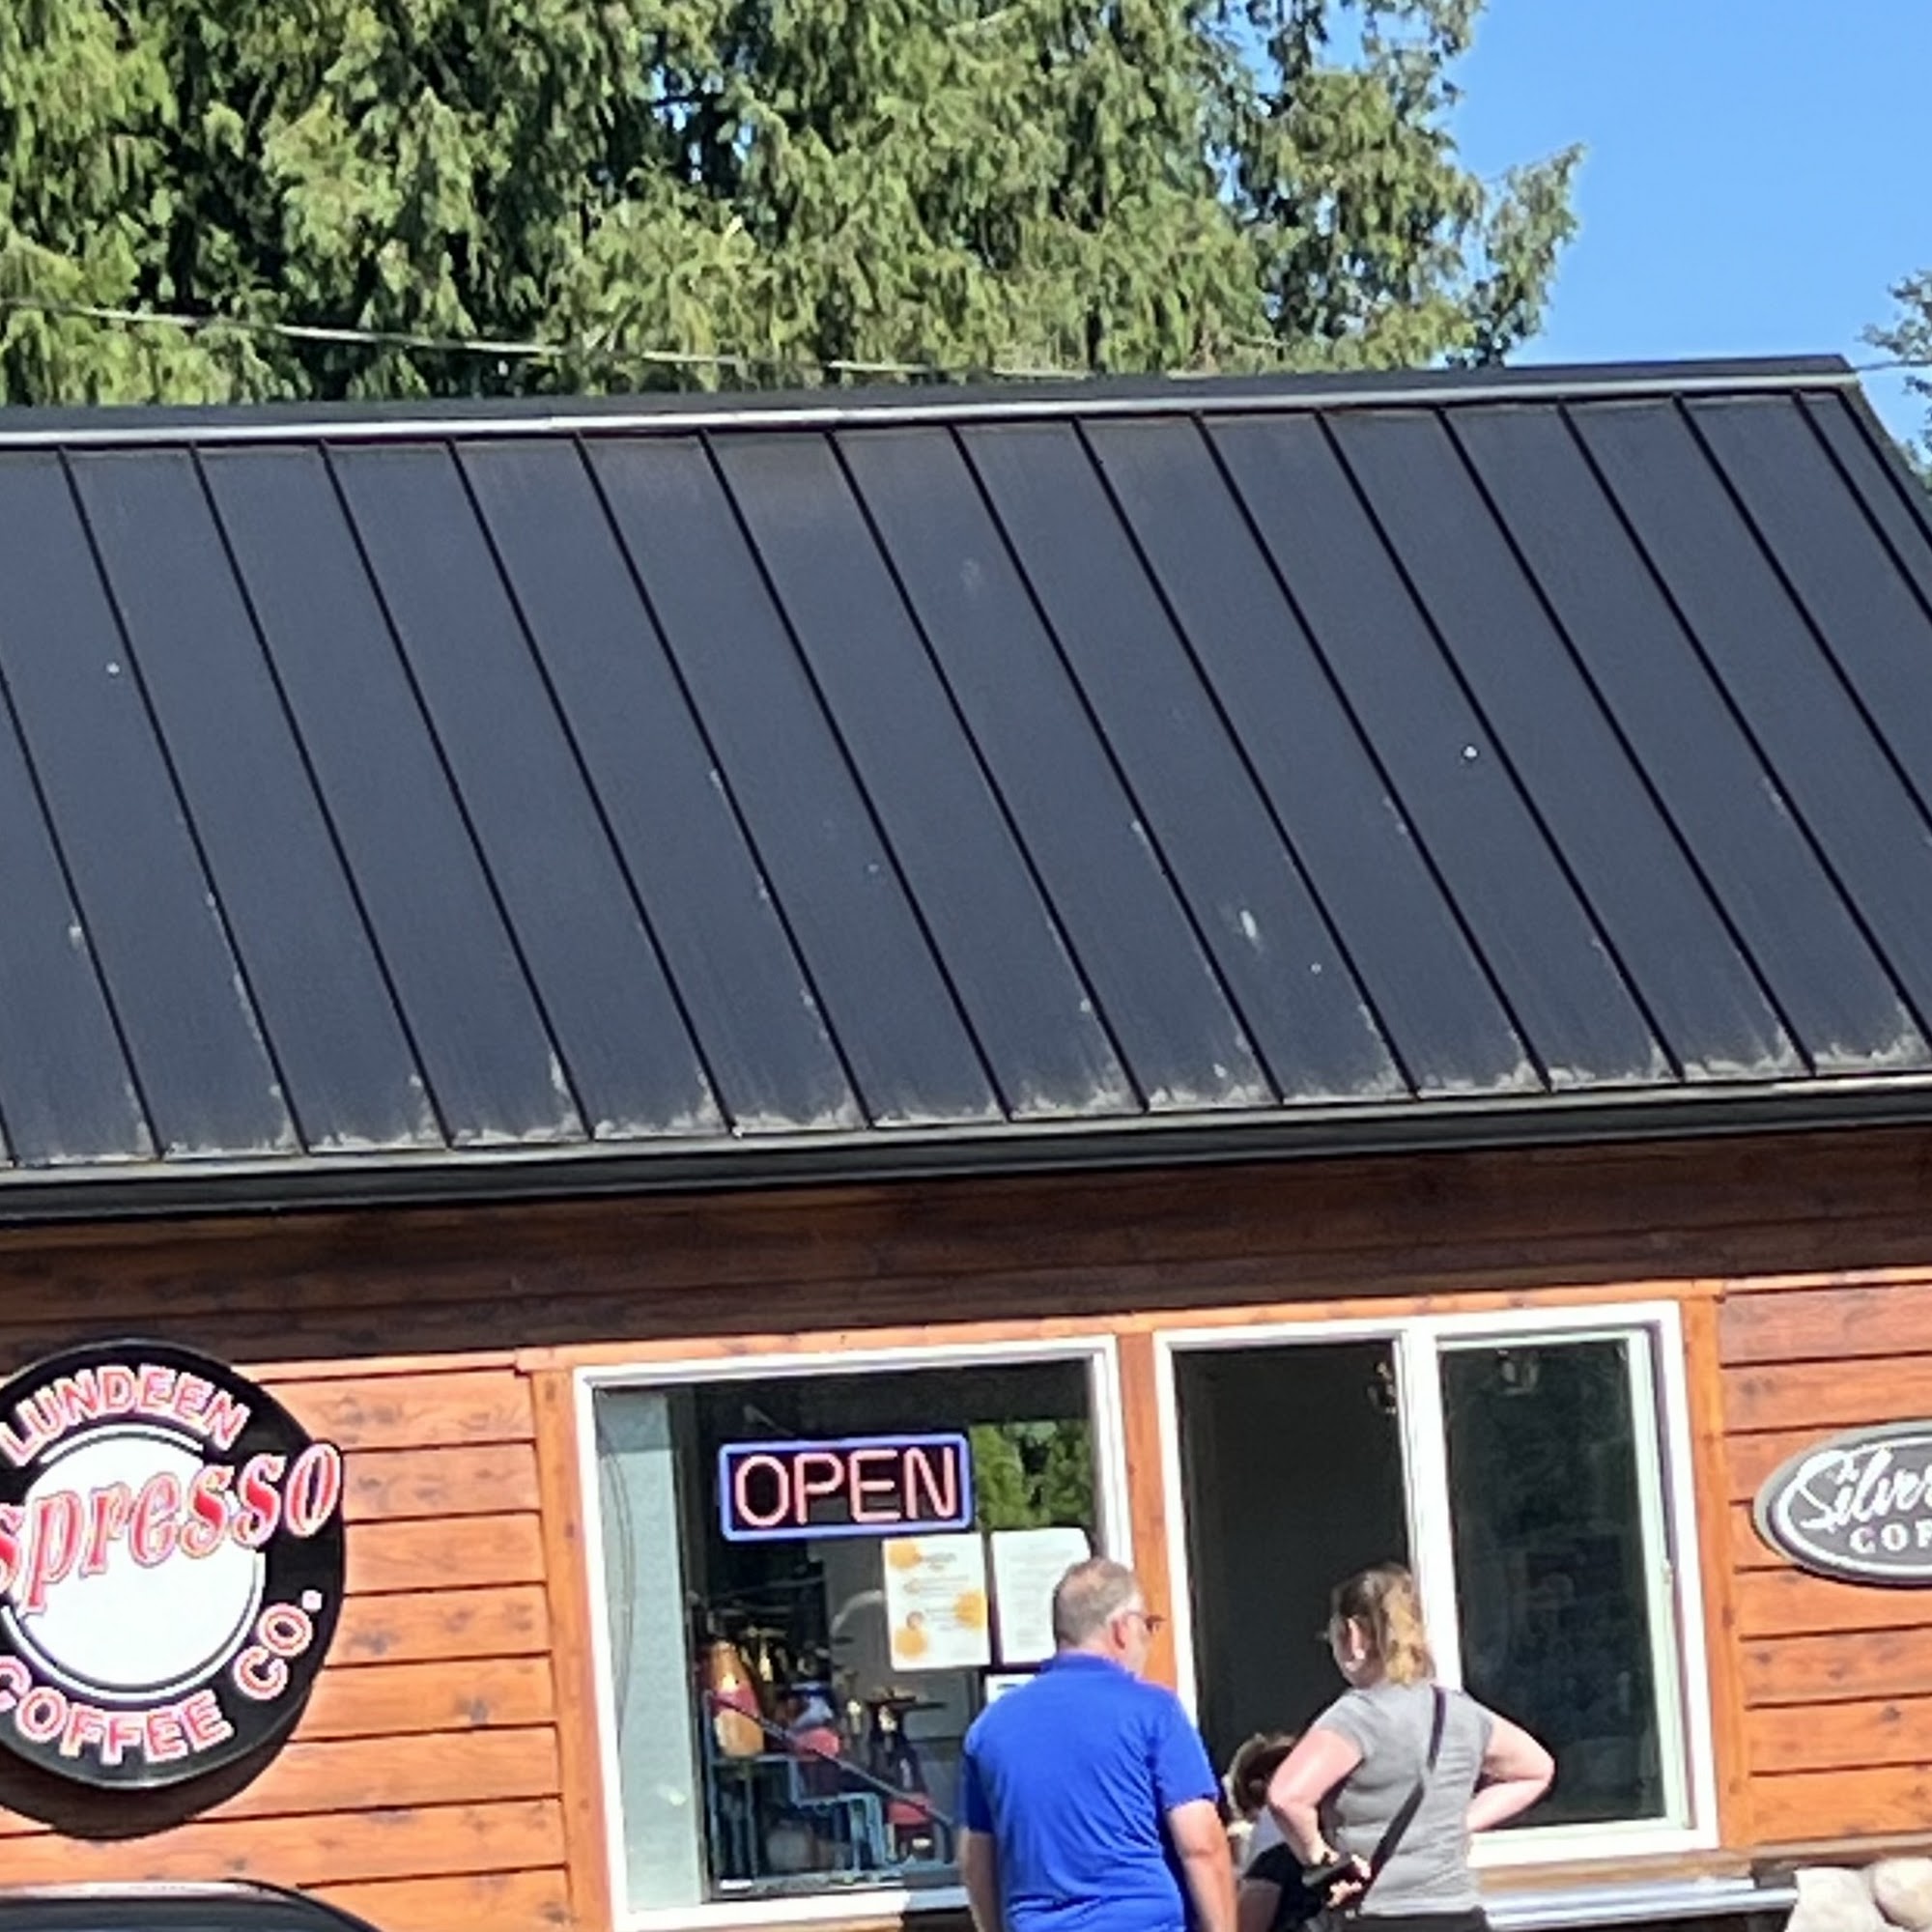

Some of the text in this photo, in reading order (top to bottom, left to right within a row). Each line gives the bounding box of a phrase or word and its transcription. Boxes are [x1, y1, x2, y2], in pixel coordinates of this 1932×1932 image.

[0, 1365, 250, 1466] LUNDEEN
[734, 1447, 956, 1527] OPEN
[0, 1590, 323, 1764] COFFEE CO.
